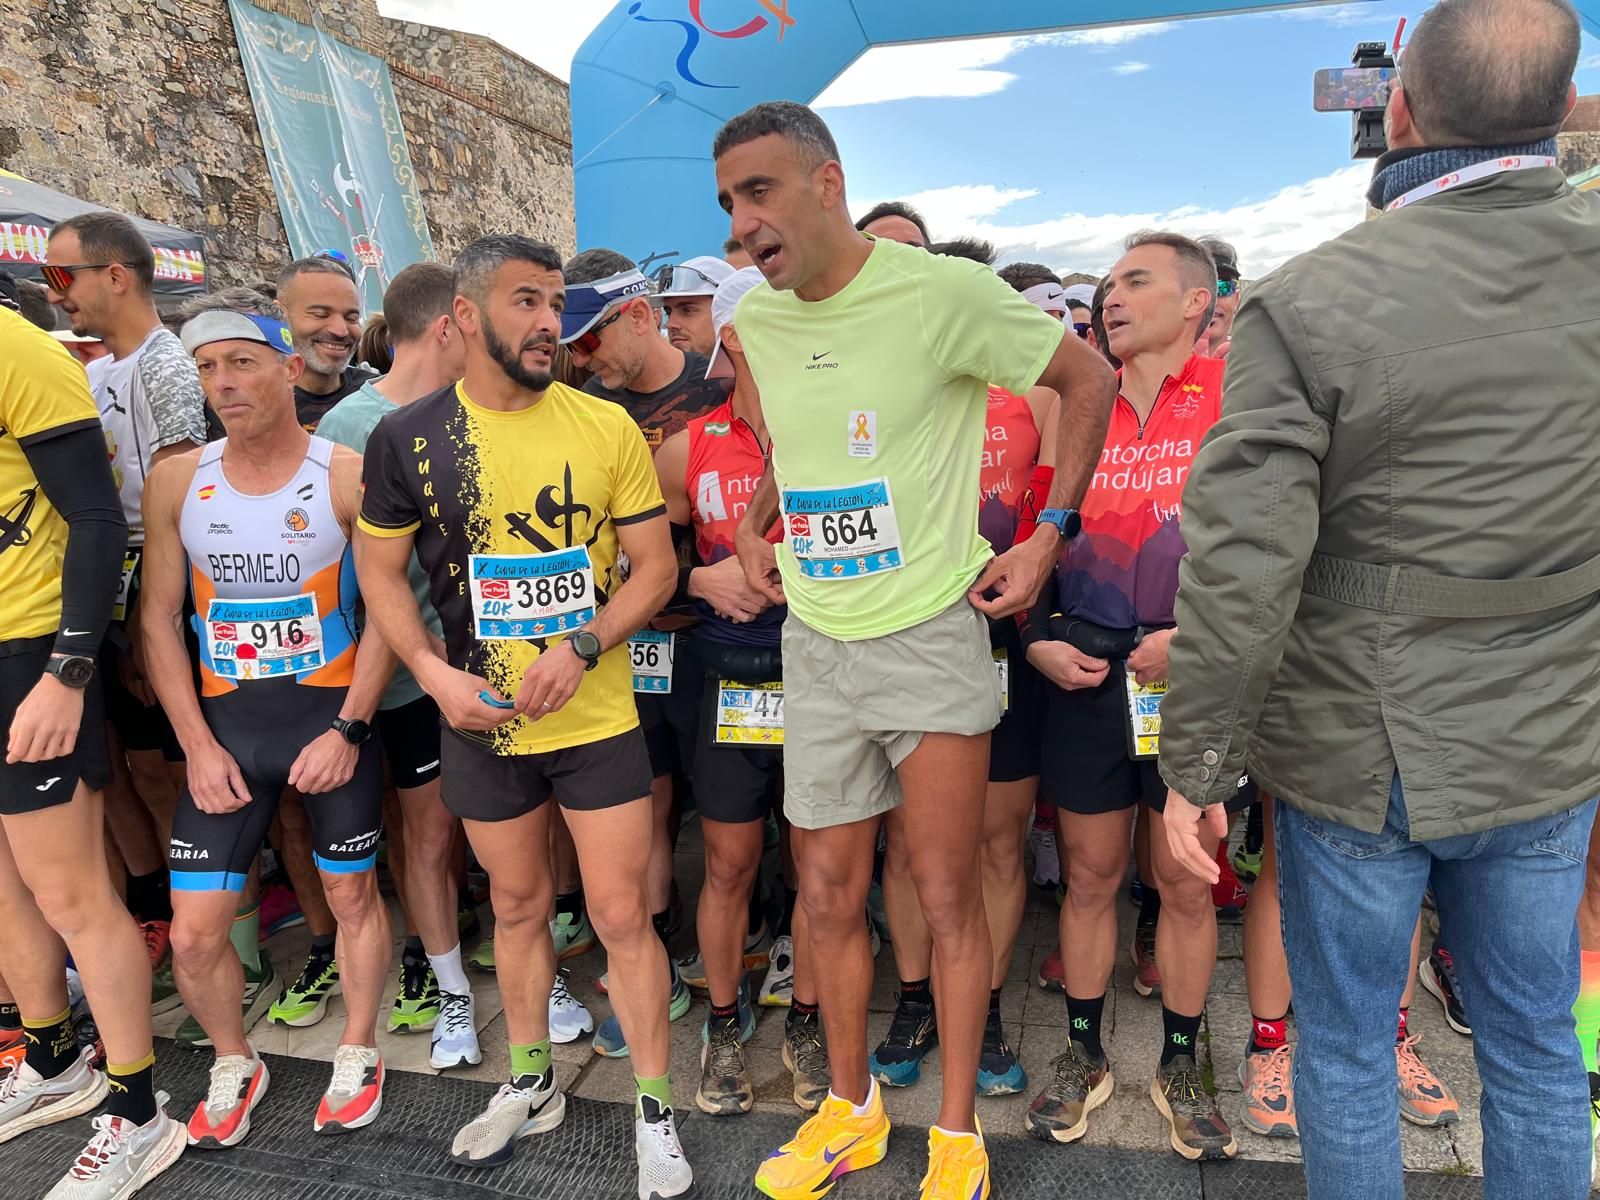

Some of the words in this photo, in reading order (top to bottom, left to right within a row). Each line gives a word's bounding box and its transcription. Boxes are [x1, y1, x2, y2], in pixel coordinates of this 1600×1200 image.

[822, 510, 878, 546] 664
[793, 537, 814, 554] 20K
[207, 553, 300, 583] BERMEJO
[516, 571, 586, 609] 3869
[482, 600, 513, 617] 20K
[251, 619, 304, 649] 916
[627, 643, 659, 668] 56
